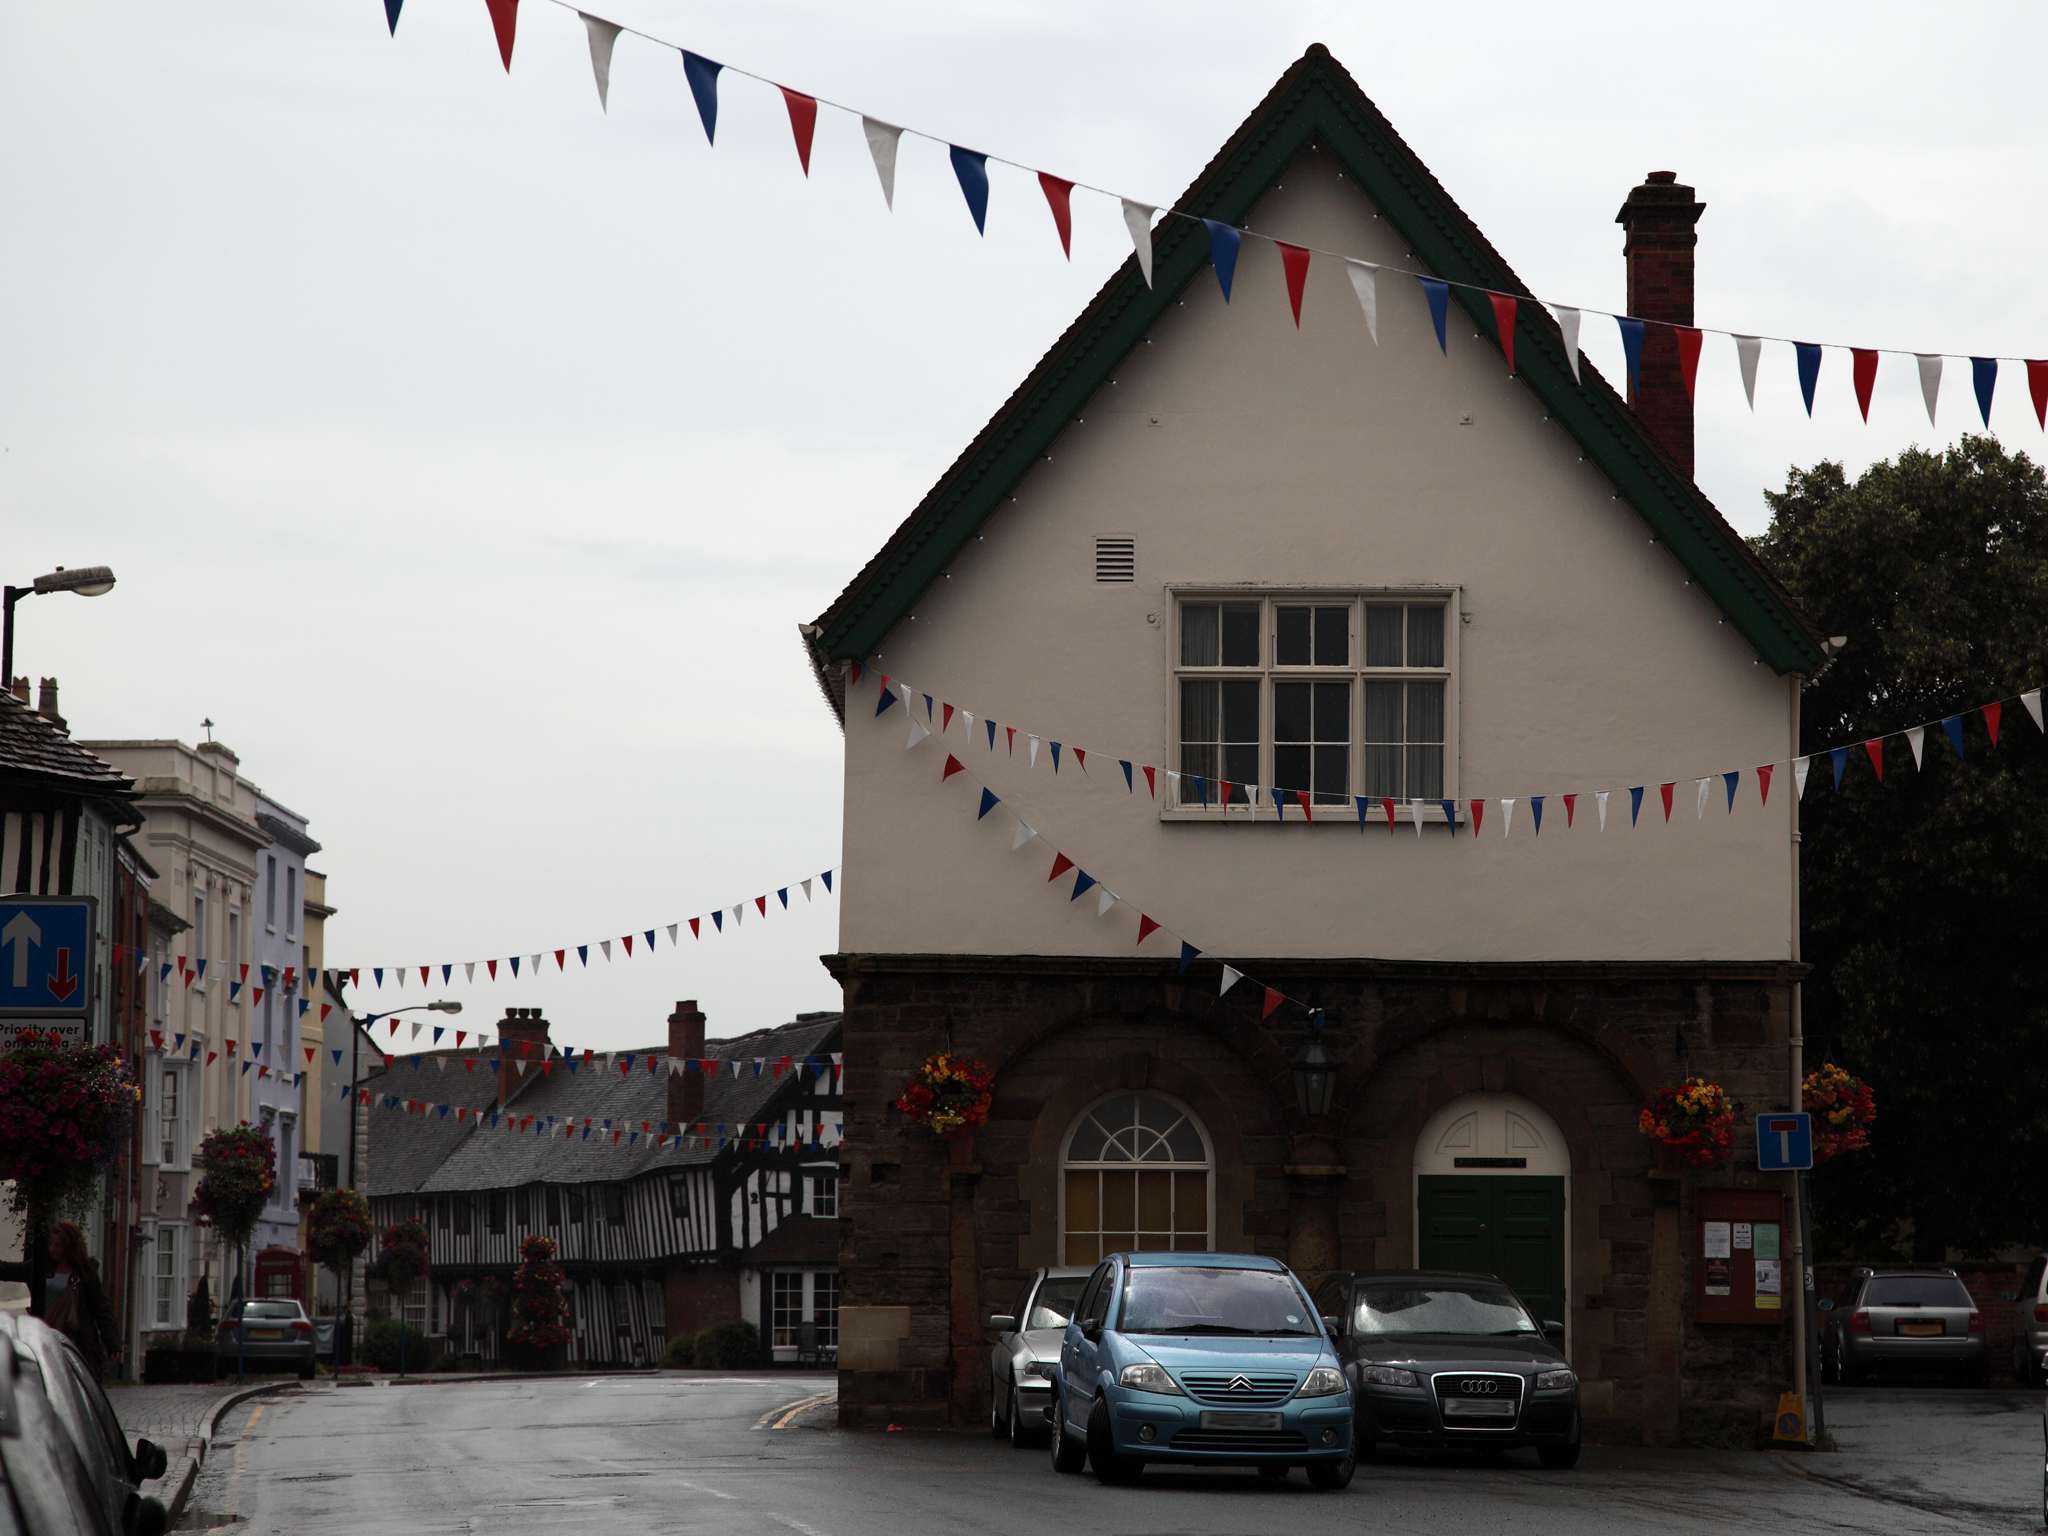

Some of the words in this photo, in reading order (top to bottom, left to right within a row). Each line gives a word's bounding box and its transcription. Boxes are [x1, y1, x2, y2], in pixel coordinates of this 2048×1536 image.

[50, 1026, 80, 1035] over
[1703, 1203, 1741, 1214] TOWN
[1746, 1204, 1778, 1215] HALL
